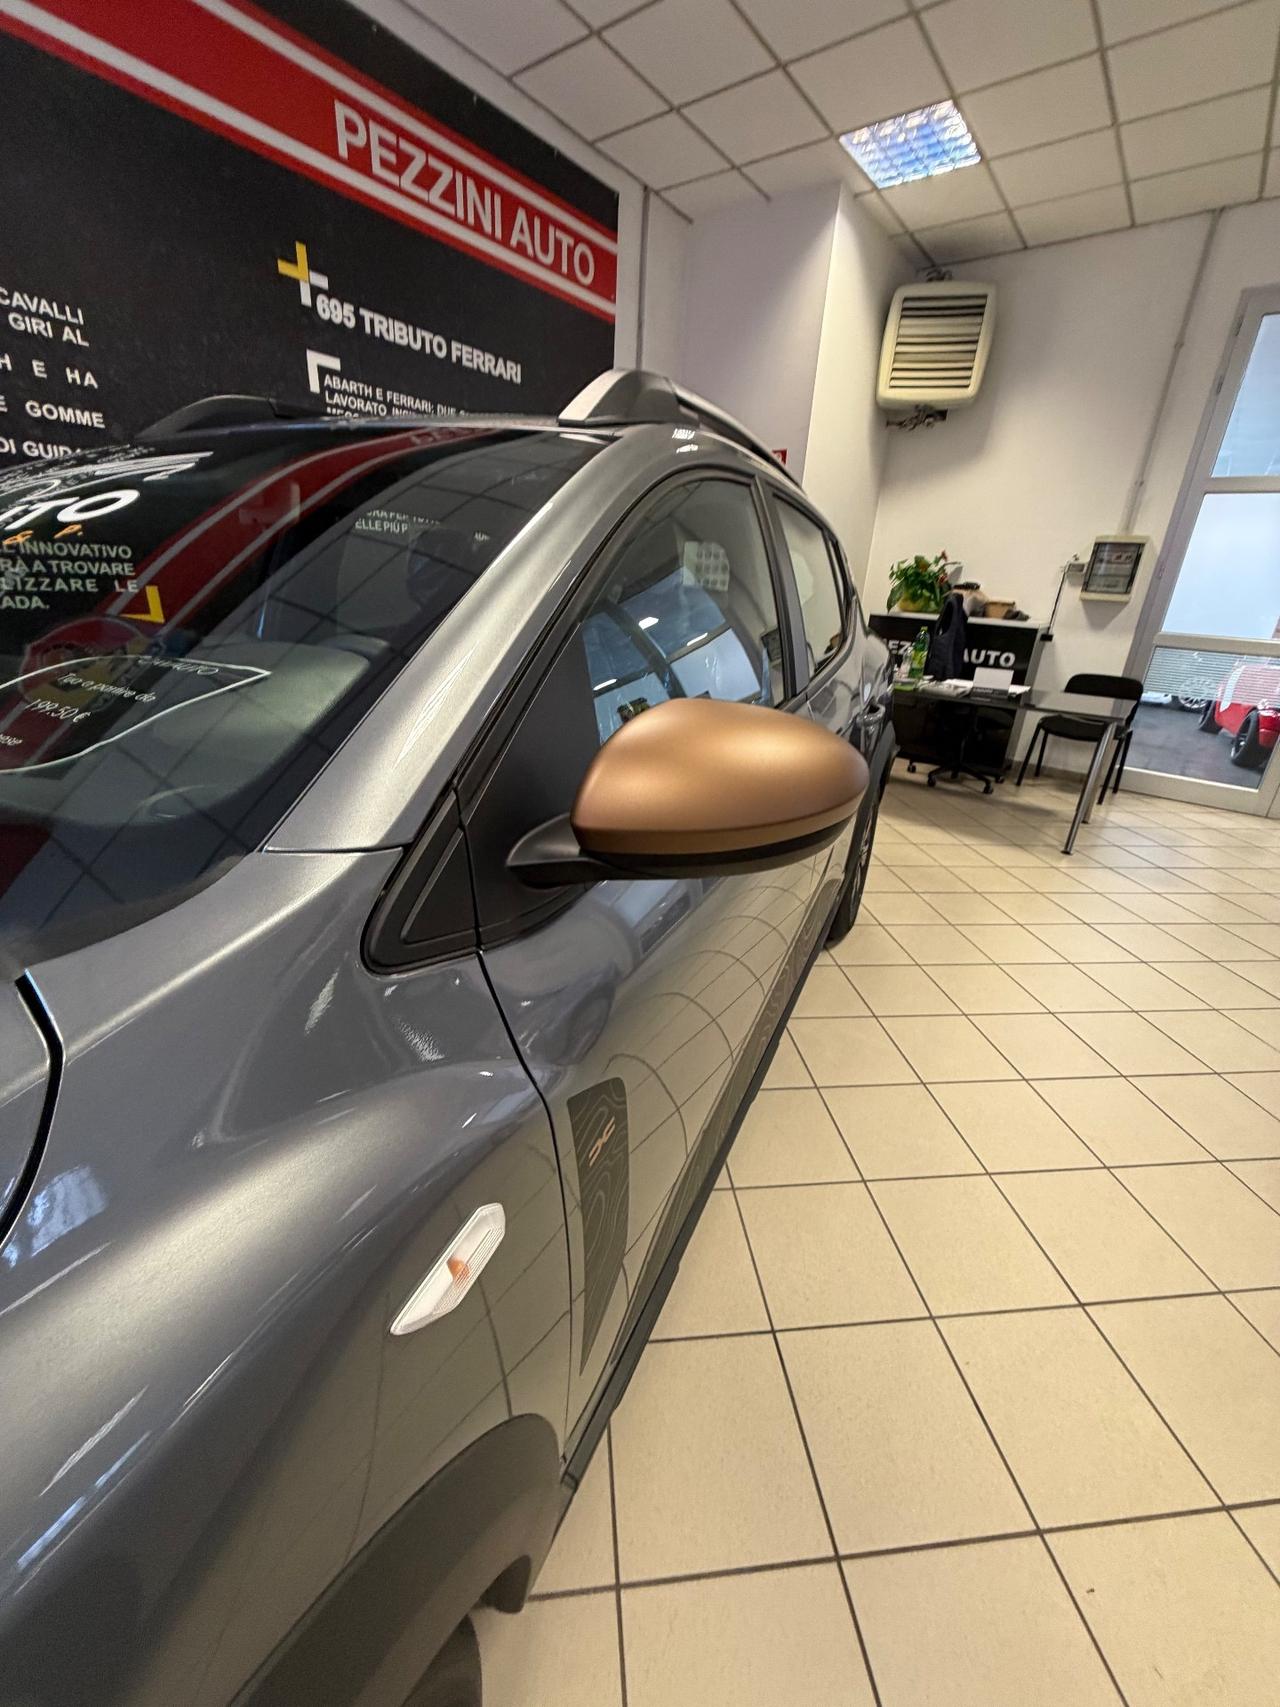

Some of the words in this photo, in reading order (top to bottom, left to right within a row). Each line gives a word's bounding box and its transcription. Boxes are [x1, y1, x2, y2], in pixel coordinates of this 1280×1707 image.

[334, 99, 502, 241] PEZZINI
[509, 206, 595, 286] AUTO
[8, 312, 53, 339] GIRI
[62, 325, 89, 347] AL
[316, 293, 356, 329] 695
[359, 308, 447, 358] TRIBUTO
[451, 340, 521, 385] FERRARI
[32, 359, 47, 378] E
[65, 367, 98, 389] HA
[323, 374, 373, 398] ABARTH
[375, 388, 384, 401] E
[25, 400, 105, 428] GOMME
[325, 390, 387, 417] LAVORATO
[33, 560, 47, 574] A
[48, 560, 136, 577] TROVARE
[114, 580, 138, 593] LE
